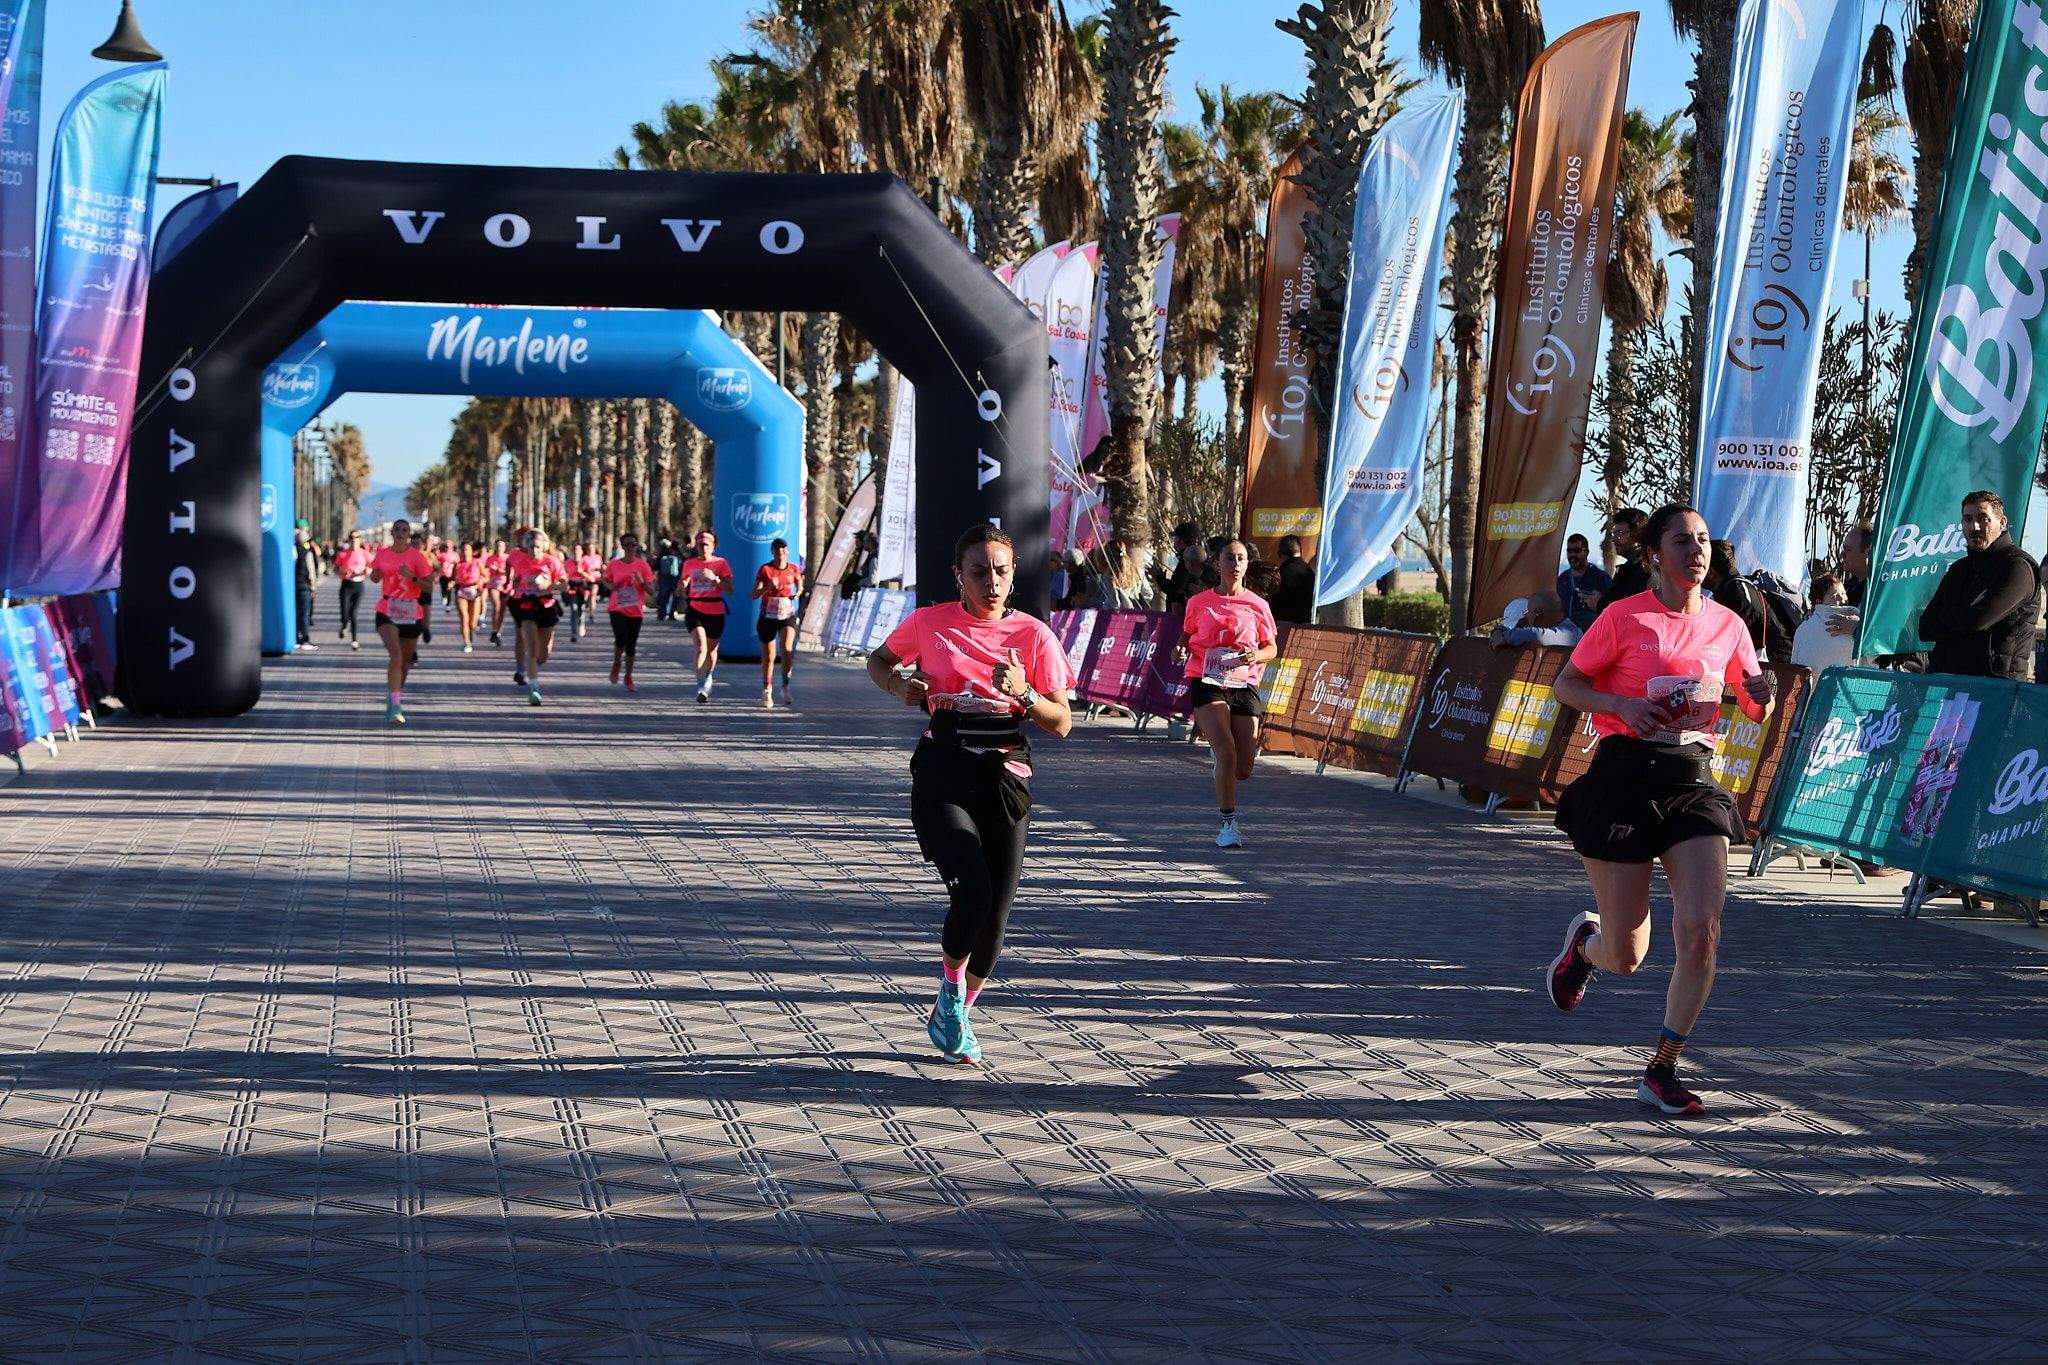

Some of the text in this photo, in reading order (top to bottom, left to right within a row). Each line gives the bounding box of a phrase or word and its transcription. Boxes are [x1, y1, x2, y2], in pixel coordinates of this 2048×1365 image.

[1771, 90, 1805, 274] Odontológicos
[1809, 136, 1831, 272] Clínicas dentales
[383, 209, 804, 255] VOLVO
[1744, 148, 1771, 271] Institutos
[1549, 154, 1584, 325] Odontológicos
[1388, 216, 1420, 349] Odontológicos
[1522, 209, 1552, 324] Institutos
[1576, 206, 1600, 325] Clínicas dentales
[1371, 258, 1396, 347] Institutos
[427, 315, 588, 385] Marlene
[52, 389, 105, 410] SÚMATE
[701, 377, 749, 400] Marlene
[1717, 457, 1803, 472] www.ioa.es
[1718, 443, 1748, 455] 900
[1753, 443, 1774, 455] 131
[1347, 480, 1406, 490] www.ioa.es
[1368, 471, 1384, 480] 131
[1386, 472, 1408, 480] 002
[168, 367, 197, 671] VOLVO
[735, 504, 787, 529] Marlene
[1881, 561, 1939, 582] CHAMPÚ
[1732, 721, 1762, 749] 002
[1978, 811, 2044, 851] CHAMPÚ
